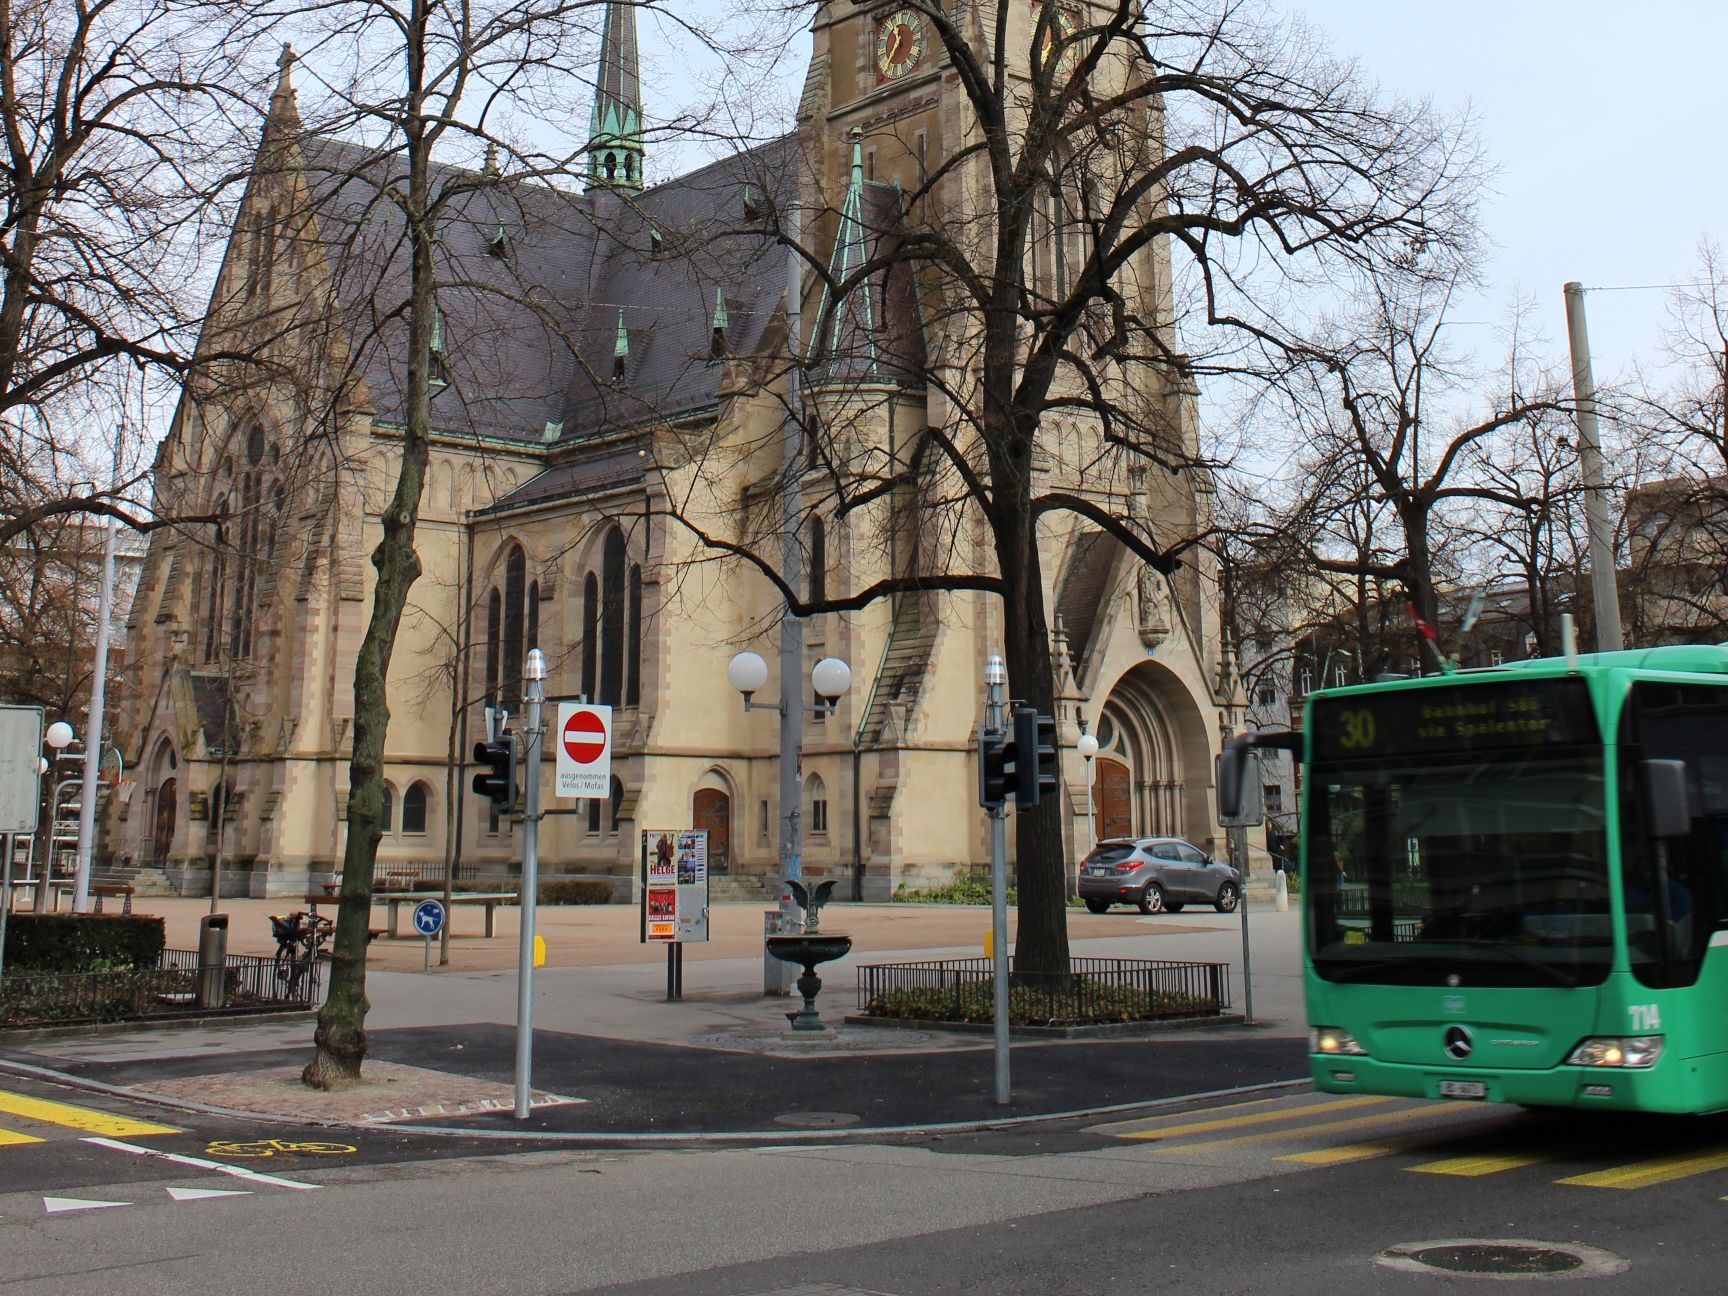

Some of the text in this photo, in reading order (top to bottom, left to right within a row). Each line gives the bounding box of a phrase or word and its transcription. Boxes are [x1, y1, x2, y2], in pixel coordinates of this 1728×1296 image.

[1340, 708, 1376, 748] 30
[560, 772, 607, 780] ausgenommen
[562, 781, 580, 789] Velos
[584, 782, 604, 790] Mofas
[650, 864, 676, 875] HELGE
[1628, 1003, 1662, 1031] 714
